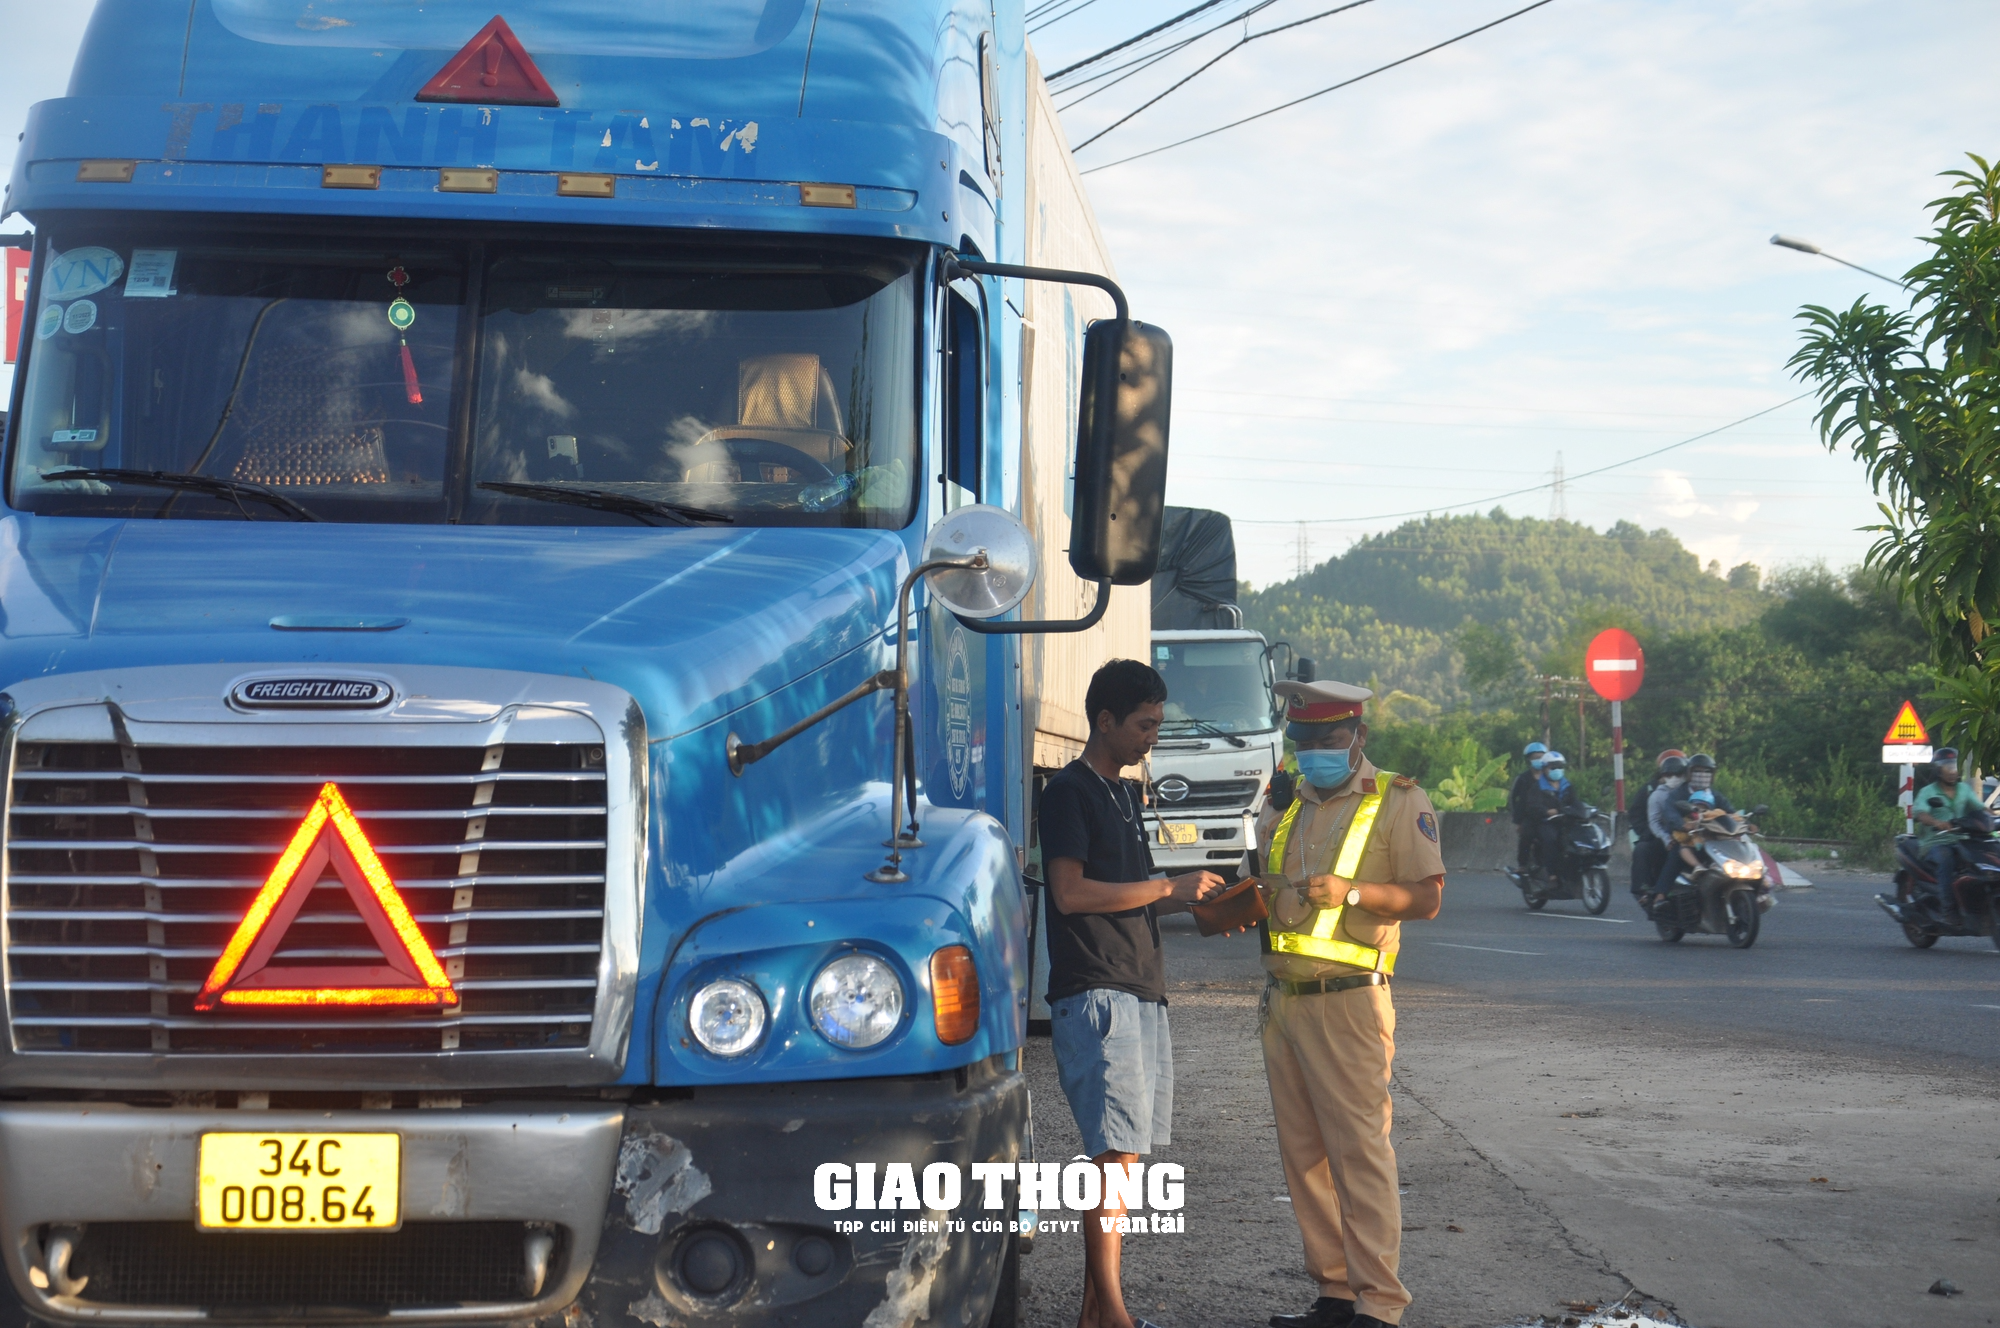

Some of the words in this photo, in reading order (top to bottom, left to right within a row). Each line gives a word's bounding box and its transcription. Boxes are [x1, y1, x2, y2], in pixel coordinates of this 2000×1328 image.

[159, 101, 502, 164] THANH
[51, 256, 112, 292] VN
[250, 682, 373, 697] FREIGHTLINER
[1233, 769, 1262, 777] 500
[259, 1139, 342, 1177] 34C
[221, 1185, 375, 1223] 008.64
